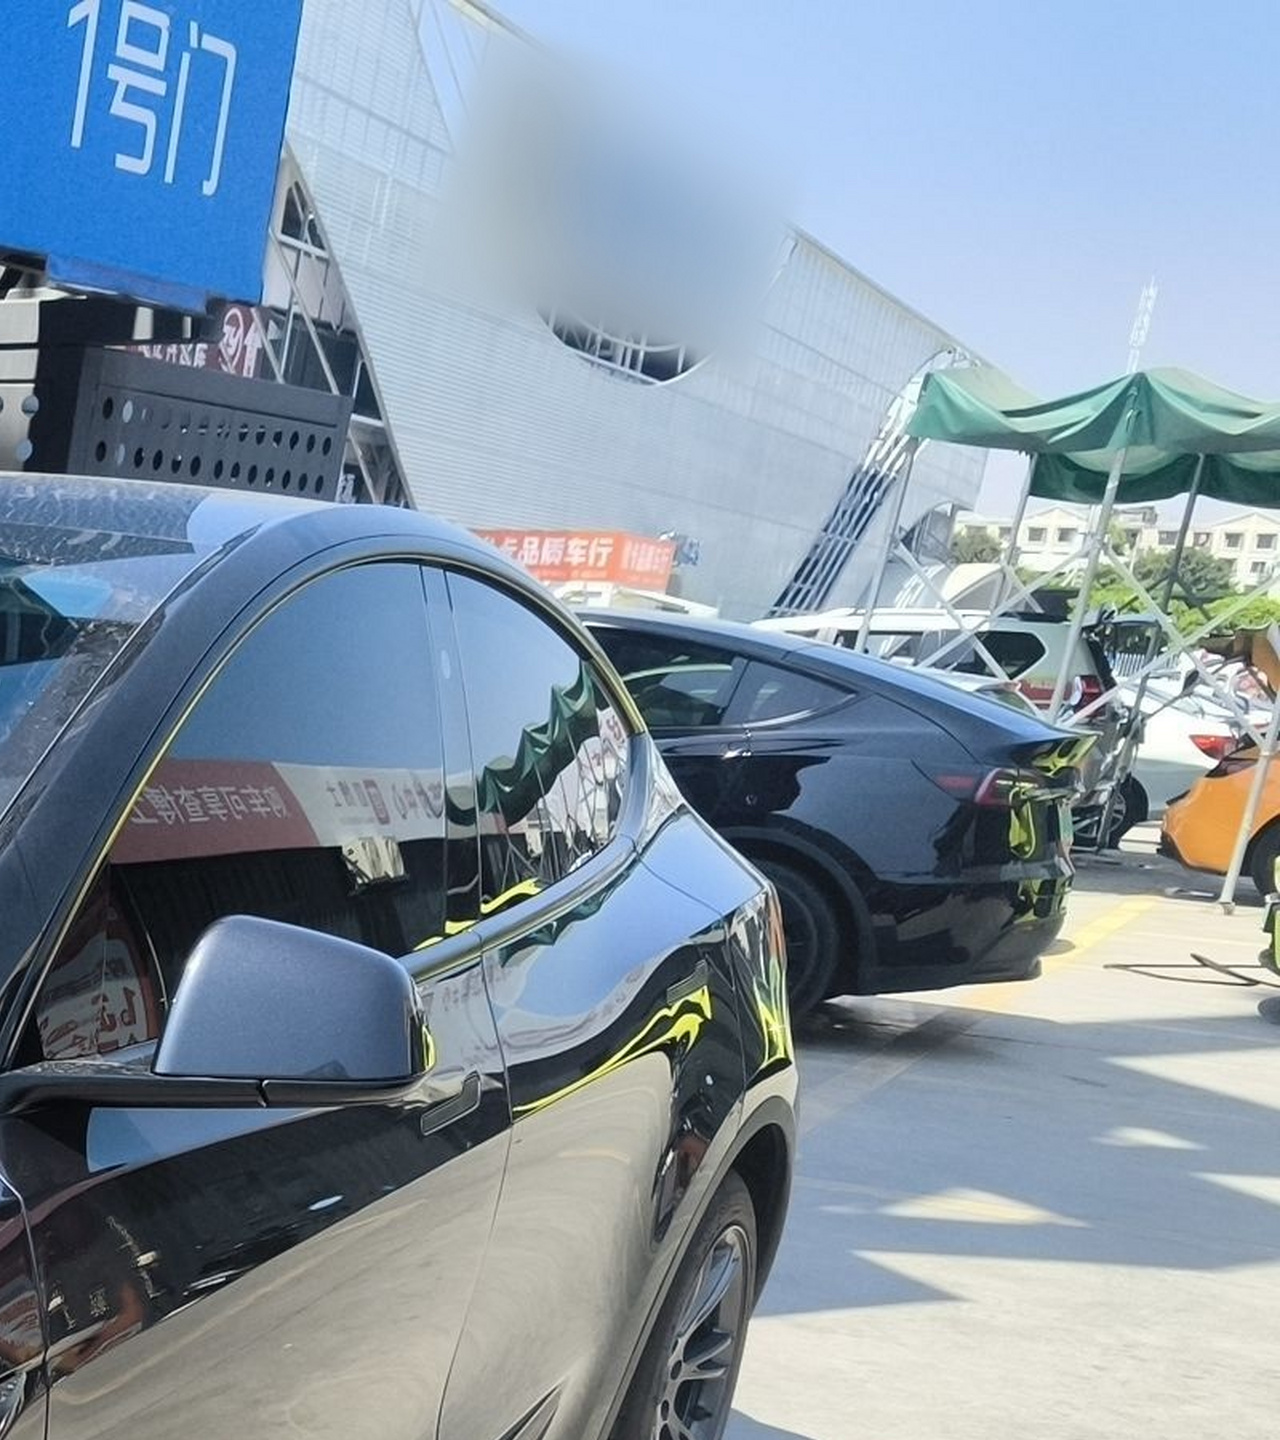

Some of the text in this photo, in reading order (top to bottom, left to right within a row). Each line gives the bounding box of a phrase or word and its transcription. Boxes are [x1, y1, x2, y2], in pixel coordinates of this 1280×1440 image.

[66, 0, 238, 196] 1号门
[485, 536, 614, 567] 品质车行
